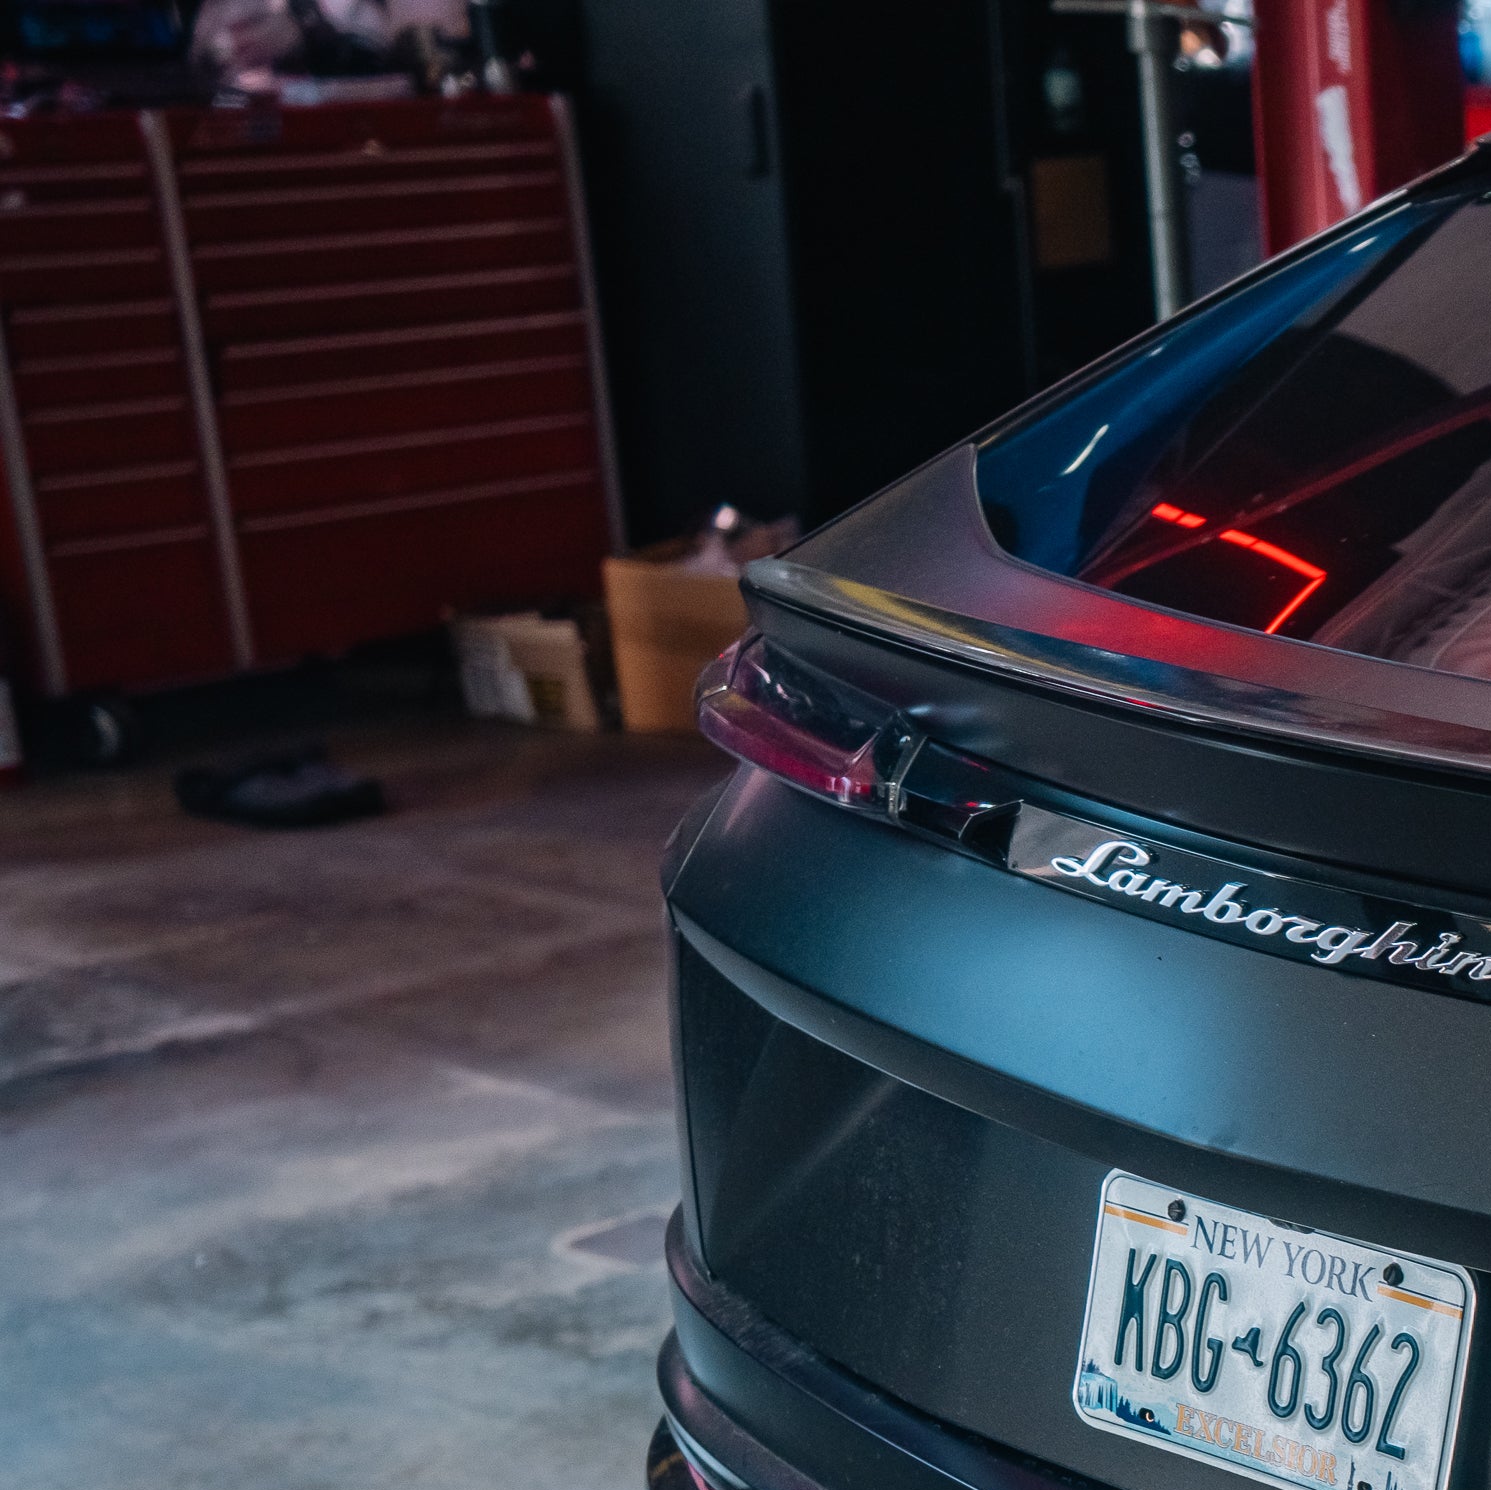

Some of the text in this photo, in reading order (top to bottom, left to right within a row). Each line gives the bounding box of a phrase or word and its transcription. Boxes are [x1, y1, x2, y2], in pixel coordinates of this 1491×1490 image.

[1190, 1215, 1376, 1301] NEW YORK
[1114, 1248, 1420, 1460] KBG 6362
[1173, 1402, 1338, 1485] EXCELSIOR
